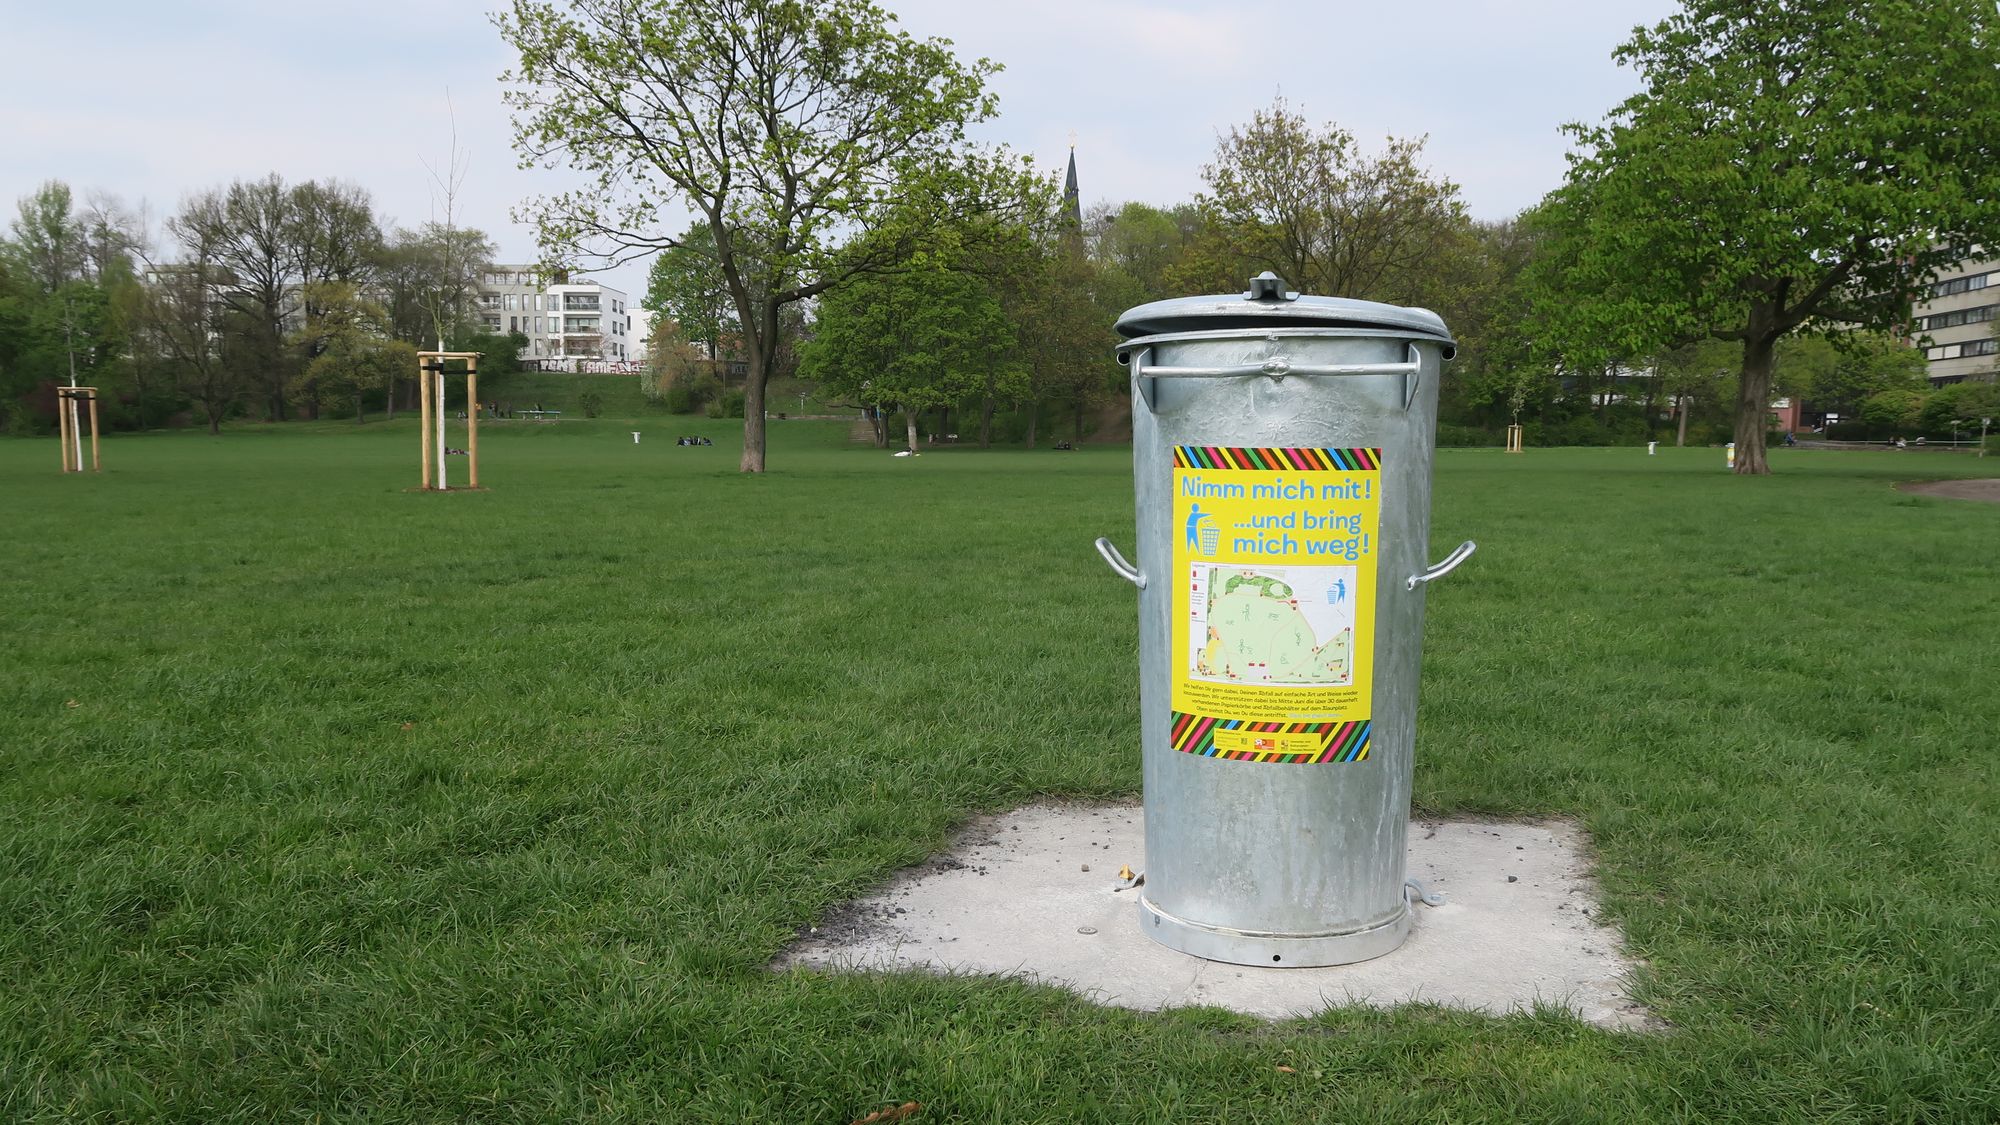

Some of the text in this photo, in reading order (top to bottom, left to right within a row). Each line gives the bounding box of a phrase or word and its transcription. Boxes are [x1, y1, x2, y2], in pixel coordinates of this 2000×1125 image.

[1182, 475, 1371, 500] Nimm mich mit!
[1233, 509, 1362, 535] ...und bring
[1233, 531, 1369, 561] mich weg!
